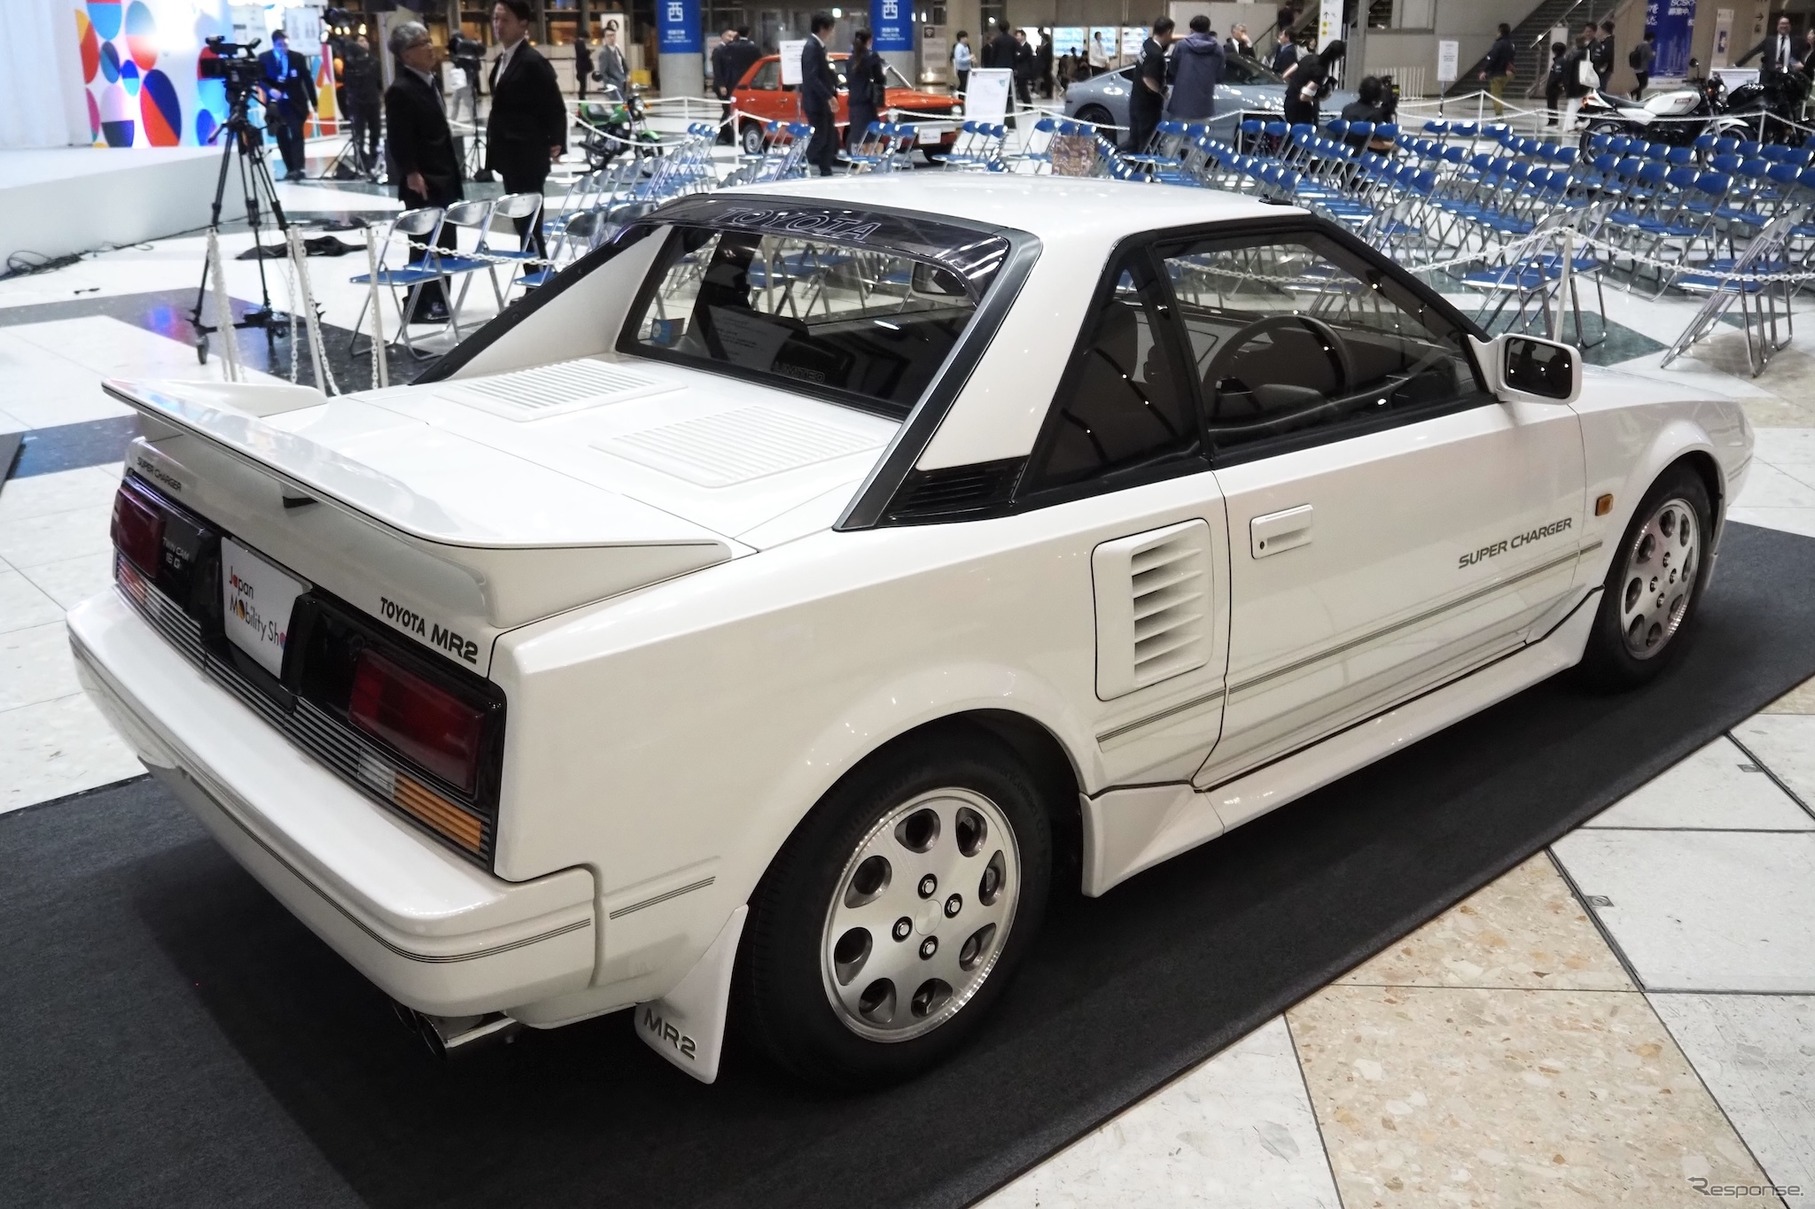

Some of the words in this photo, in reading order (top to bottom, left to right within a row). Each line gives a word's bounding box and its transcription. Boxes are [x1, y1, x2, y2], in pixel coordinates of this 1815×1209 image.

[667, 2, 684, 22] 西
[882, 0, 898, 19] 西
[711, 206, 882, 241] TOYOTA
[136, 456, 154, 475] SUPER
[154, 469, 182, 492] CHARGER
[175, 546, 190, 562] CAM
[1458, 540, 1508, 569] SUPER
[1510, 517, 1572, 549] CHARGER
[229, 566, 254, 600] Japan
[229, 594, 267, 641] Mobility
[380, 596, 426, 637] TOYOTA
[430, 623, 479, 665] MR2
[643, 1007, 697, 1060] MR2
